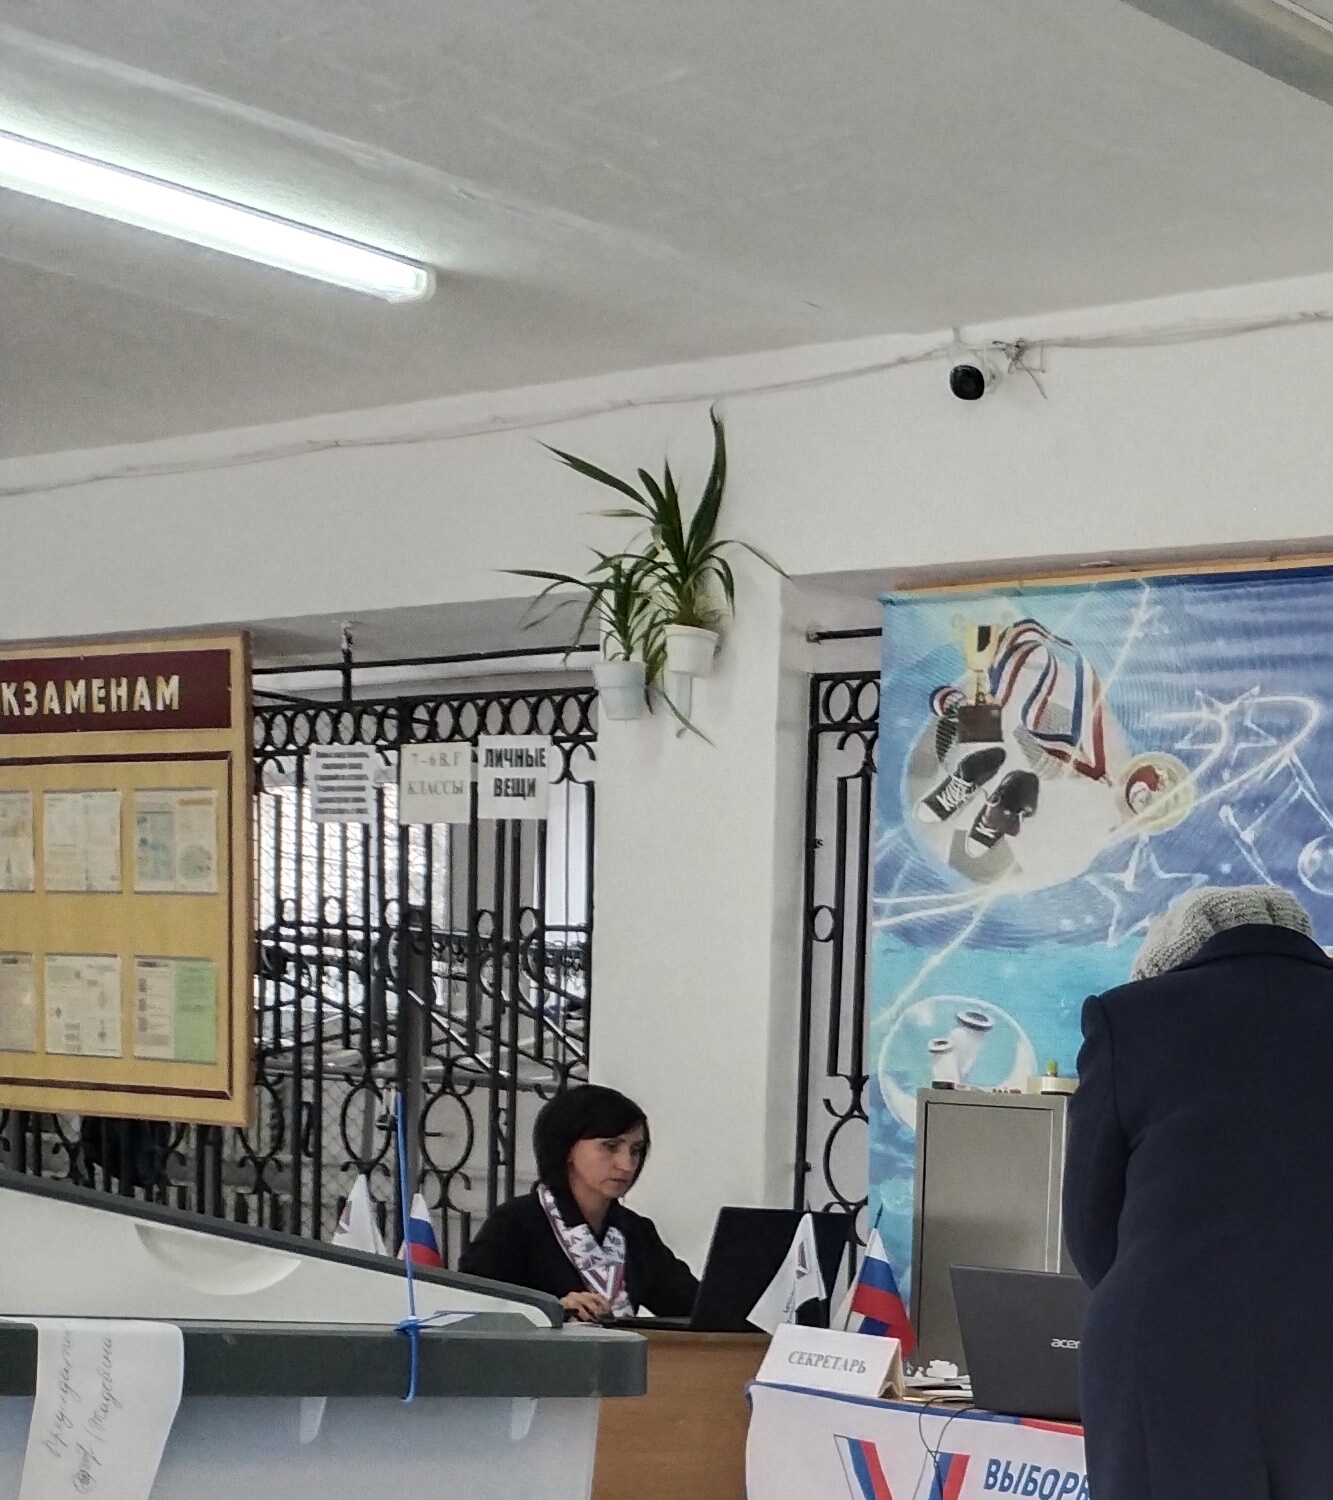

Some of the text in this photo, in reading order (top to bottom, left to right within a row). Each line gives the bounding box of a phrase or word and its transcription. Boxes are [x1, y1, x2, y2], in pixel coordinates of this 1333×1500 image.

[1, 675, 180, 716] КЗАМЕНАМ
[483, 748, 547, 768] ЛИЧНЫЕ
[407, 780, 464, 795] КЛАССЫ
[493, 777, 537, 800] ВЕЩИ
[1051, 1338, 1081, 1349] acer
[787, 1350, 867, 1374] СЕКРЕТАРЬ
